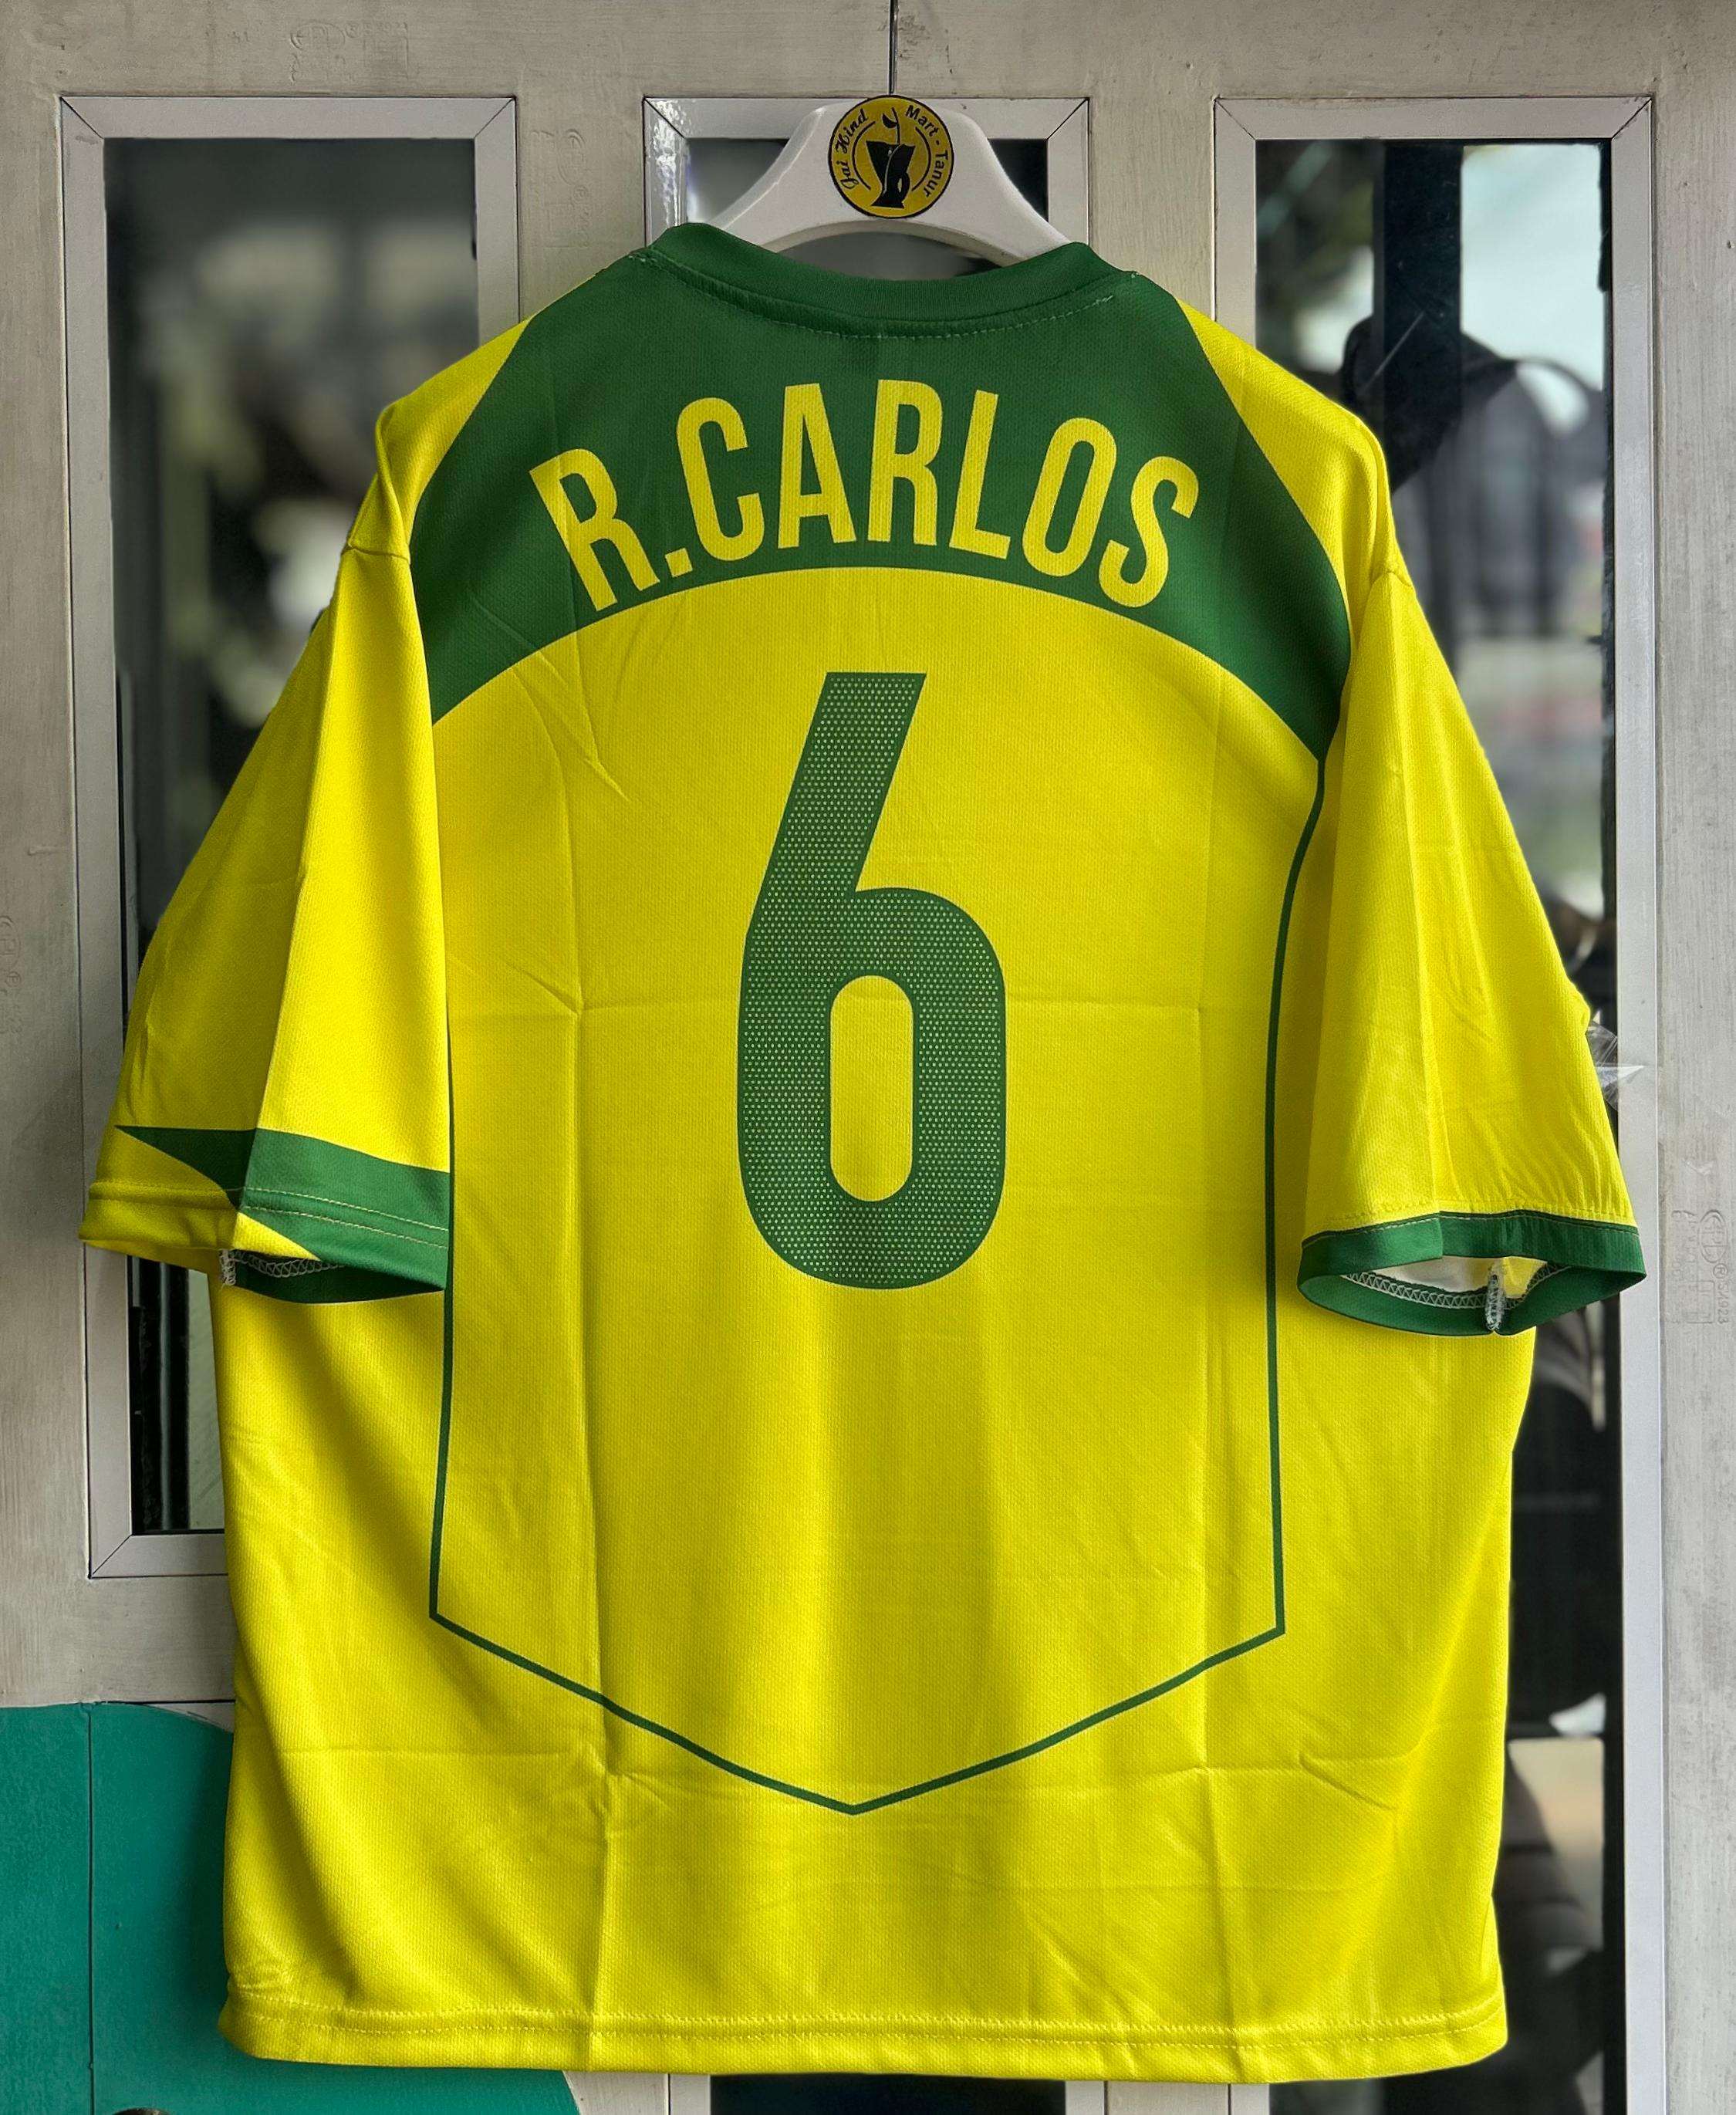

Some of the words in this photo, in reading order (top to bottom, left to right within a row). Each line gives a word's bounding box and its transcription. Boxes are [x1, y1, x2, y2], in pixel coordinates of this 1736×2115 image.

[835, 108, 869, 154] Hind
[905, 105, 940, 137] Mart
[836, 160, 860, 190] Jai
[923, 150, 948, 198] Tanur
[529, 379, 1199, 611] R.CARLOS
[737, 672, 1006, 1290] 6
